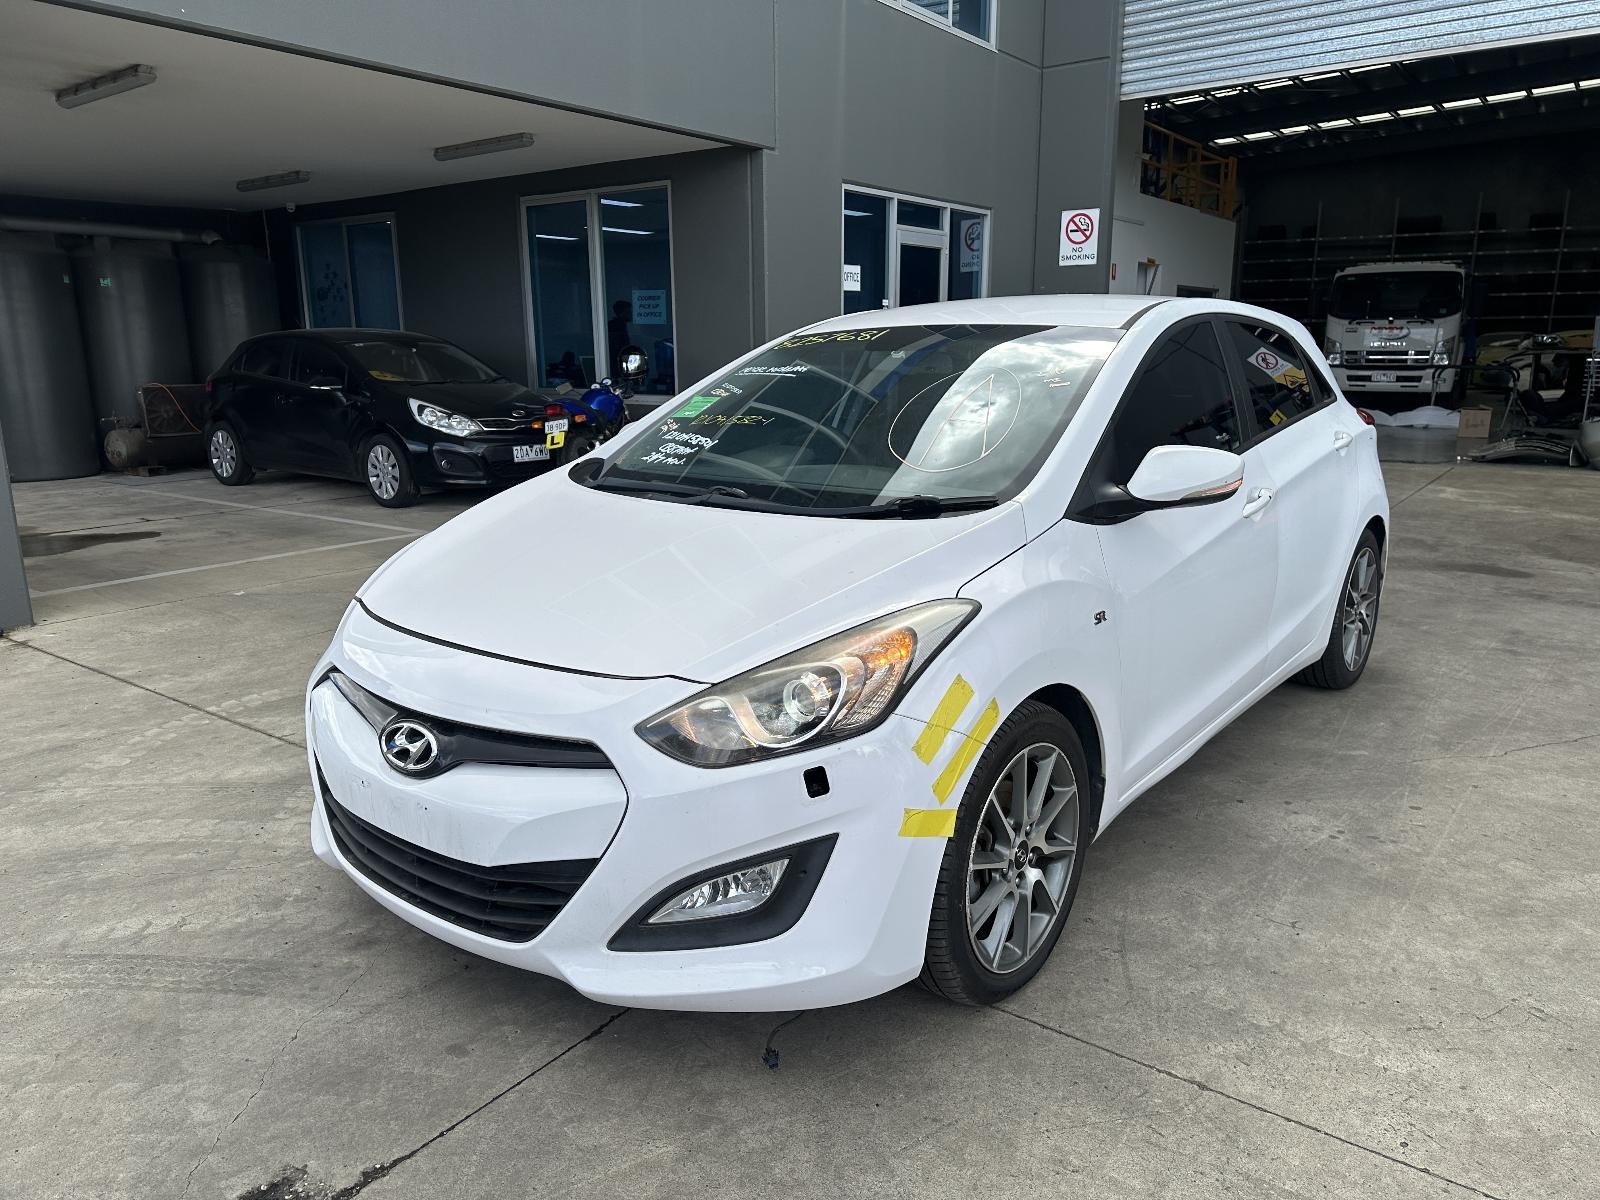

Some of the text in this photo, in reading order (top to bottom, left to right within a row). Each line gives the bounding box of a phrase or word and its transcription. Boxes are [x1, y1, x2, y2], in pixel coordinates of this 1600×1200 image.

[1060, 253, 1096, 262] SMOKING
[843, 271, 860, 283] OFFICE
[550, 435, 560, 446] L
